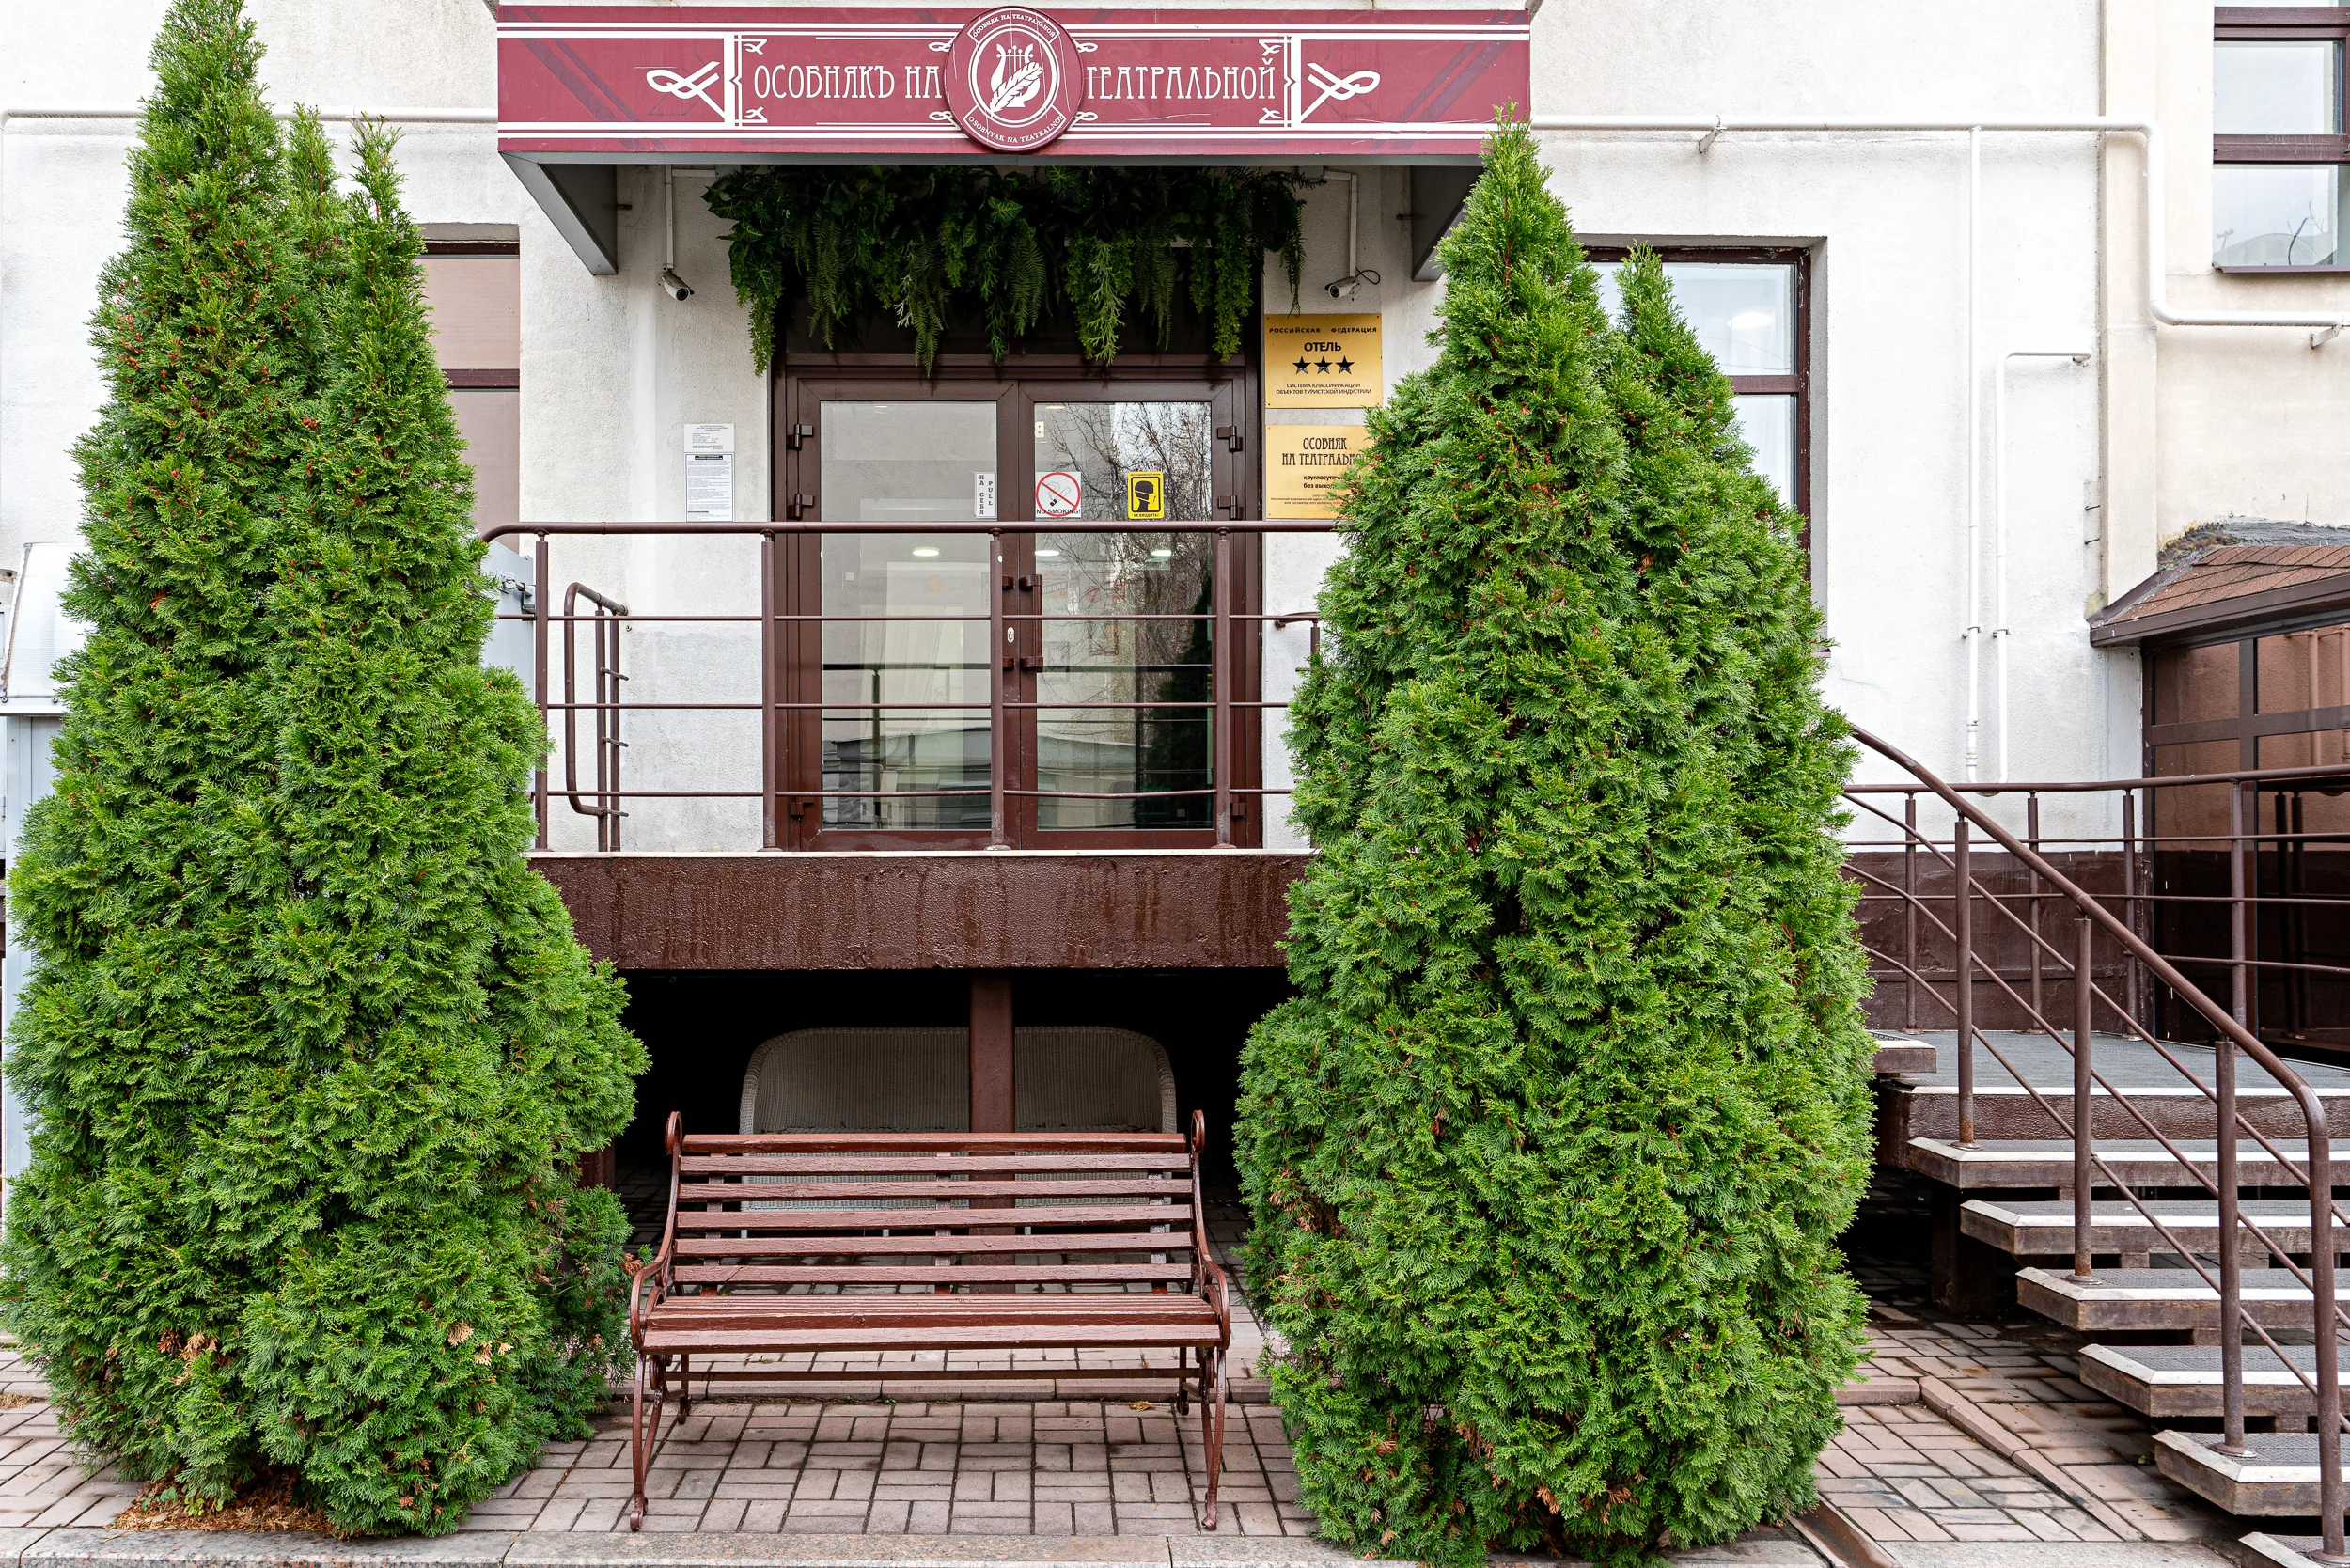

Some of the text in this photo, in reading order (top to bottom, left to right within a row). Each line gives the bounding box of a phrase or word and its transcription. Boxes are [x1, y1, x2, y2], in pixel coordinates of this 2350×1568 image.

[973, 16, 999, 38] ОСОБНЯК
[754, 57, 1276, 100] ОСОБНЯКЪ НА ТЕАТРАЛЬНОЙ
[968, 116, 1005, 142] OSOBNYAK
[1304, 342, 1342, 353] ОТЕЛЬ
[1303, 437, 1347, 450] ОСОБНЯК
[1281, 453, 1366, 466] НА ТЕАТРАЛЬН
